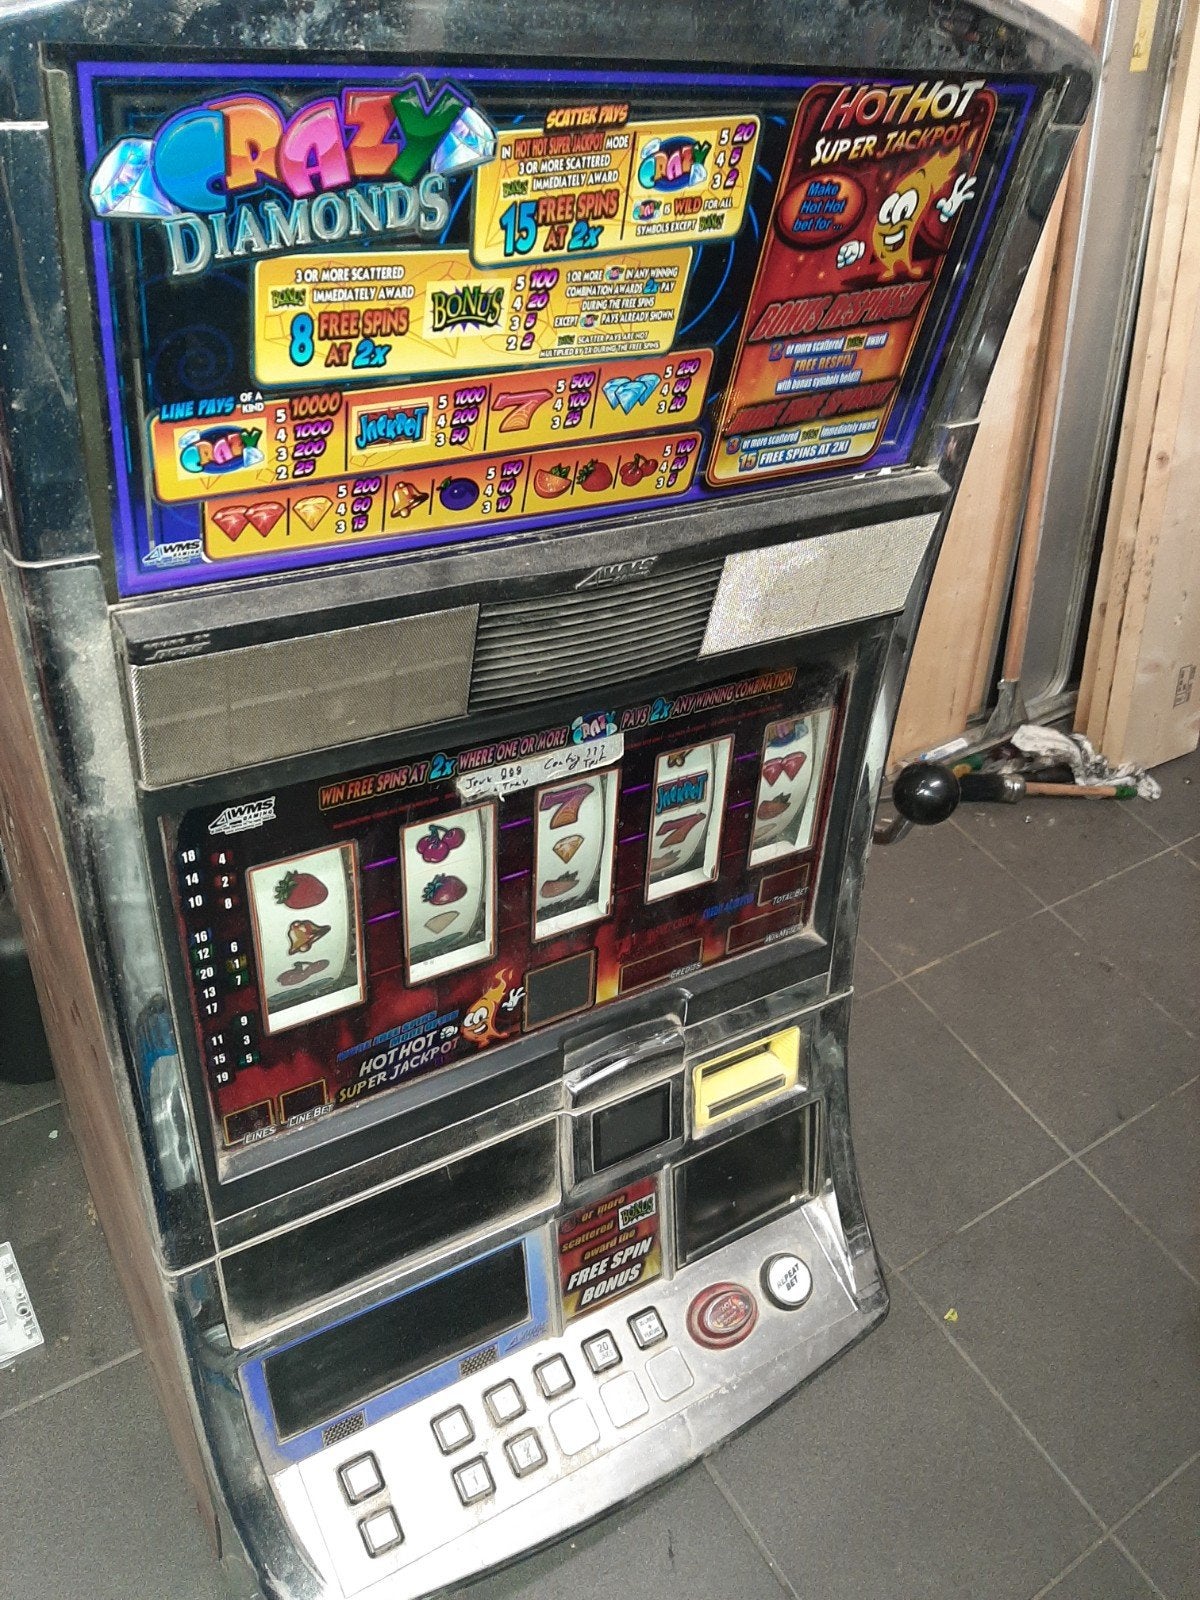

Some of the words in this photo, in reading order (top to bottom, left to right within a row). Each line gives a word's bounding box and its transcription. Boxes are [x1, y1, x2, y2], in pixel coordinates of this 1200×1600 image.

[821, 85, 912, 132] HOT
[899, 79, 986, 124] HOT
[546, 107, 597, 129] SCATTER
[598, 104, 629, 124] PAYS
[153, 79, 466, 211] CRAZY
[502, 146, 511, 159] IN
[606, 135, 630, 149] MODE
[811, 135, 877, 167] SUPER
[877, 120, 971, 157] JACKPOT
[519, 163, 525, 174] 3
[526, 161, 538, 173] OR
[540, 158, 565, 172] MORE
[566, 154, 610, 170] SCATTERED
[533, 175, 585, 190] IMMEDIATELY
[587, 171, 618, 186] AWARD
[809, 182, 839, 196] Make
[537, 194, 574, 222] FREE
[577, 190, 619, 219] SPINS
[664, 204, 670, 214] IS
[674, 197, 703, 214] WILD
[704, 200, 718, 210] FOR
[720, 199, 732, 209] ALL
[801, 201, 821, 214] Hot
[824, 199, 846, 213] Hot
[164, 176, 449, 275] DIAMONDS
[500, 201, 536, 256] 15
[636, 223, 669, 235] SYMBOLS
[670, 220, 696, 233] EXCEPT
[793, 219, 814, 232] bet
[544, 225, 567, 250] AT
[295, 270, 302, 282] 3
[304, 269, 319, 281] OR
[321, 268, 349, 281] MORE
[351, 266, 404, 280] SCATTERED
[313, 287, 374, 302] IMMEDIATELY
[377, 286, 415, 300] AWARD
[433, 286, 504, 332] BONUS
[318, 310, 359, 340] FREE
[362, 307, 409, 338] SPINS
[555, 316, 578, 326] EXCEPT
[620, 312, 649, 322] ALREADY
[290, 312, 314, 366] 8
[325, 343, 351, 367] AT
[794, 357, 817, 372] FREE
[240, 393, 252, 402] OF
[255, 392, 262, 400] A
[161, 404, 194, 421] LINE
[198, 398, 235, 417] PAYS
[242, 404, 264, 413] KIND
[277, 410, 286, 423] 5
[291, 393, 342, 419] 10000
[276, 429, 286, 442] 4
[294, 419, 333, 439] 1000
[277, 448, 287, 461] 3
[293, 441, 326, 458] 200
[760, 453, 783, 465] FREE
[786, 448, 815, 460] SPINS
[819, 445, 831, 455] AT
[277, 467, 287, 480] 2
[293, 460, 315, 477] 25
[739, 453, 757, 471] 15
[163, 541, 200, 553] WMS
[322, 786, 345, 805] WIN
[347, 777, 374, 799] FREE
[376, 770, 407, 793] SPINS
[409, 763, 426, 782] AT
[459, 750, 494, 770] WHERE
[496, 740, 519, 761] ONE
[521, 736, 537, 754] OR
[538, 728, 567, 749] MORE
[621, 706, 650, 728] PAYS
[673, 695, 693, 716] ANY
[694, 685, 733, 708] WINNING
[735, 671, 794, 697] COMBINATION
[231, 800, 273, 817] WMS
[182, 850, 195, 863] 18
[219, 853, 226, 865] 4
[185, 873, 199, 886] 14
[221, 876, 229, 887] 2
[189, 895, 202, 908] 10
[224, 898, 232, 909] 8
[194, 931, 207, 944] 16
[197, 947, 210, 960] 12
[230, 942, 237, 952] 6
[233, 959, 240, 969] 1
[200, 967, 213, 980] 20
[235, 975, 241, 986] 7
[203, 987, 216, 999] 13
[206, 1003, 218, 1015] 17
[241, 1016, 247, 1026] 9
[212, 1034, 223, 1046] 11
[243, 1035, 250, 1045] 3
[213, 1053, 225, 1065] 15
[245, 1053, 252, 1064] 5
[359, 1050, 399, 1077] HOT
[399, 1031, 436, 1062] HOT
[216, 1071, 229, 1083] 19
[339, 1073, 387, 1102] SUPER
[389, 1038, 460, 1080] JACKPOT
[244, 1126, 275, 1144] LINES
[288, 1109, 312, 1128] LINE
[313, 1104, 333, 1120] BET
[581, 1211, 593, 1222] or
[597, 1195, 625, 1215] more
[562, 1221, 614, 1252] scattered
[584, 1237, 617, 1260] award
[567, 1258, 610, 1291] FREE
[610, 1237, 653, 1269] SPIN
[581, 1264, 642, 1305] BONUS
[785, 1275, 798, 1291] BET
